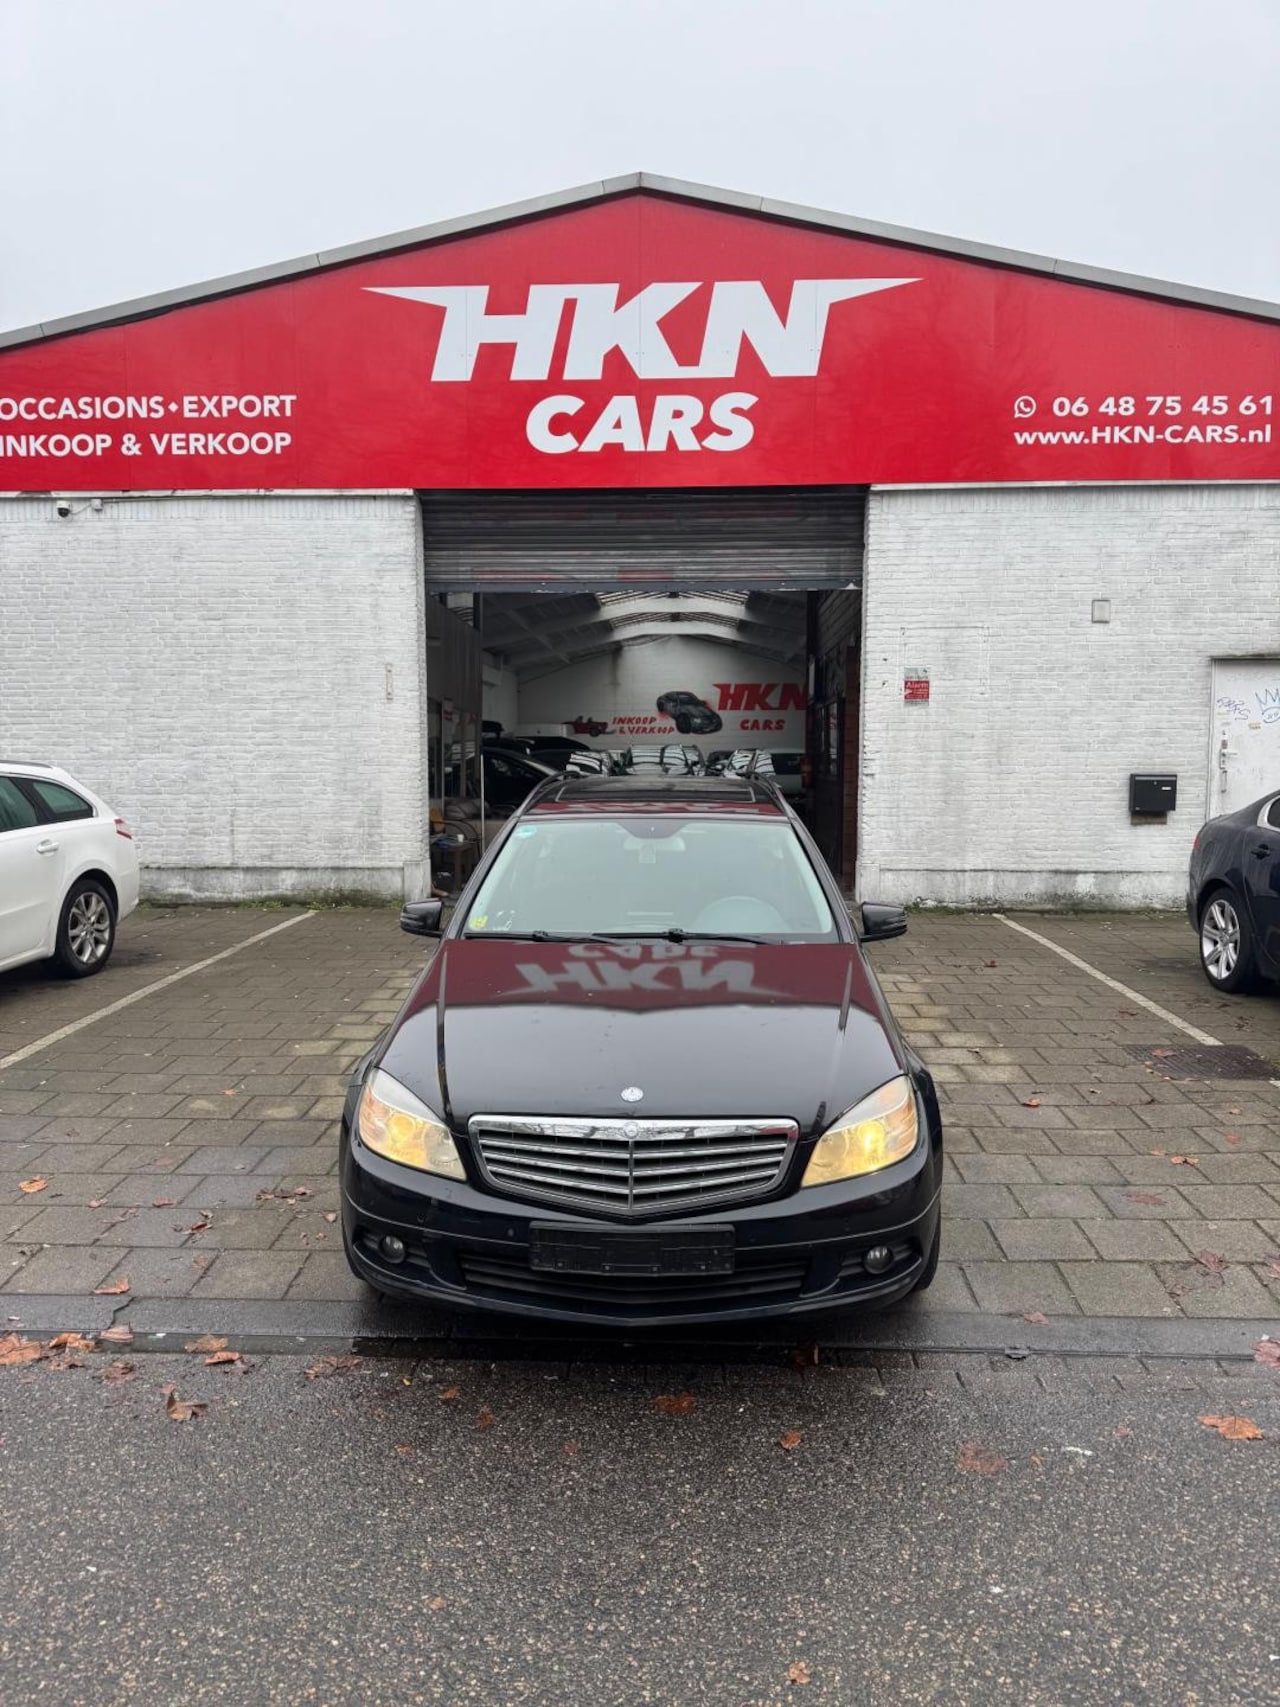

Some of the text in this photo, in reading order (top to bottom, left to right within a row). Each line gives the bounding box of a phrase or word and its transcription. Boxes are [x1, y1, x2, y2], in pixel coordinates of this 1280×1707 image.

[360, 278, 924, 381] HKN
[0, 395, 297, 420] OCCASIONS EXPORT
[1052, 395, 1272, 416] 06 48 75 45 61
[526, 392, 759, 453] CARS
[0, 432, 292, 457] INKOOP & VERKOOP
[1014, 424, 1272, 445] www.HKN-CARS.nl
[712, 683, 809, 711] HKN
[612, 716, 657, 725] INKOOP
[629, 726, 675, 735] VERKOOP
[740, 719, 786, 731] CARS
